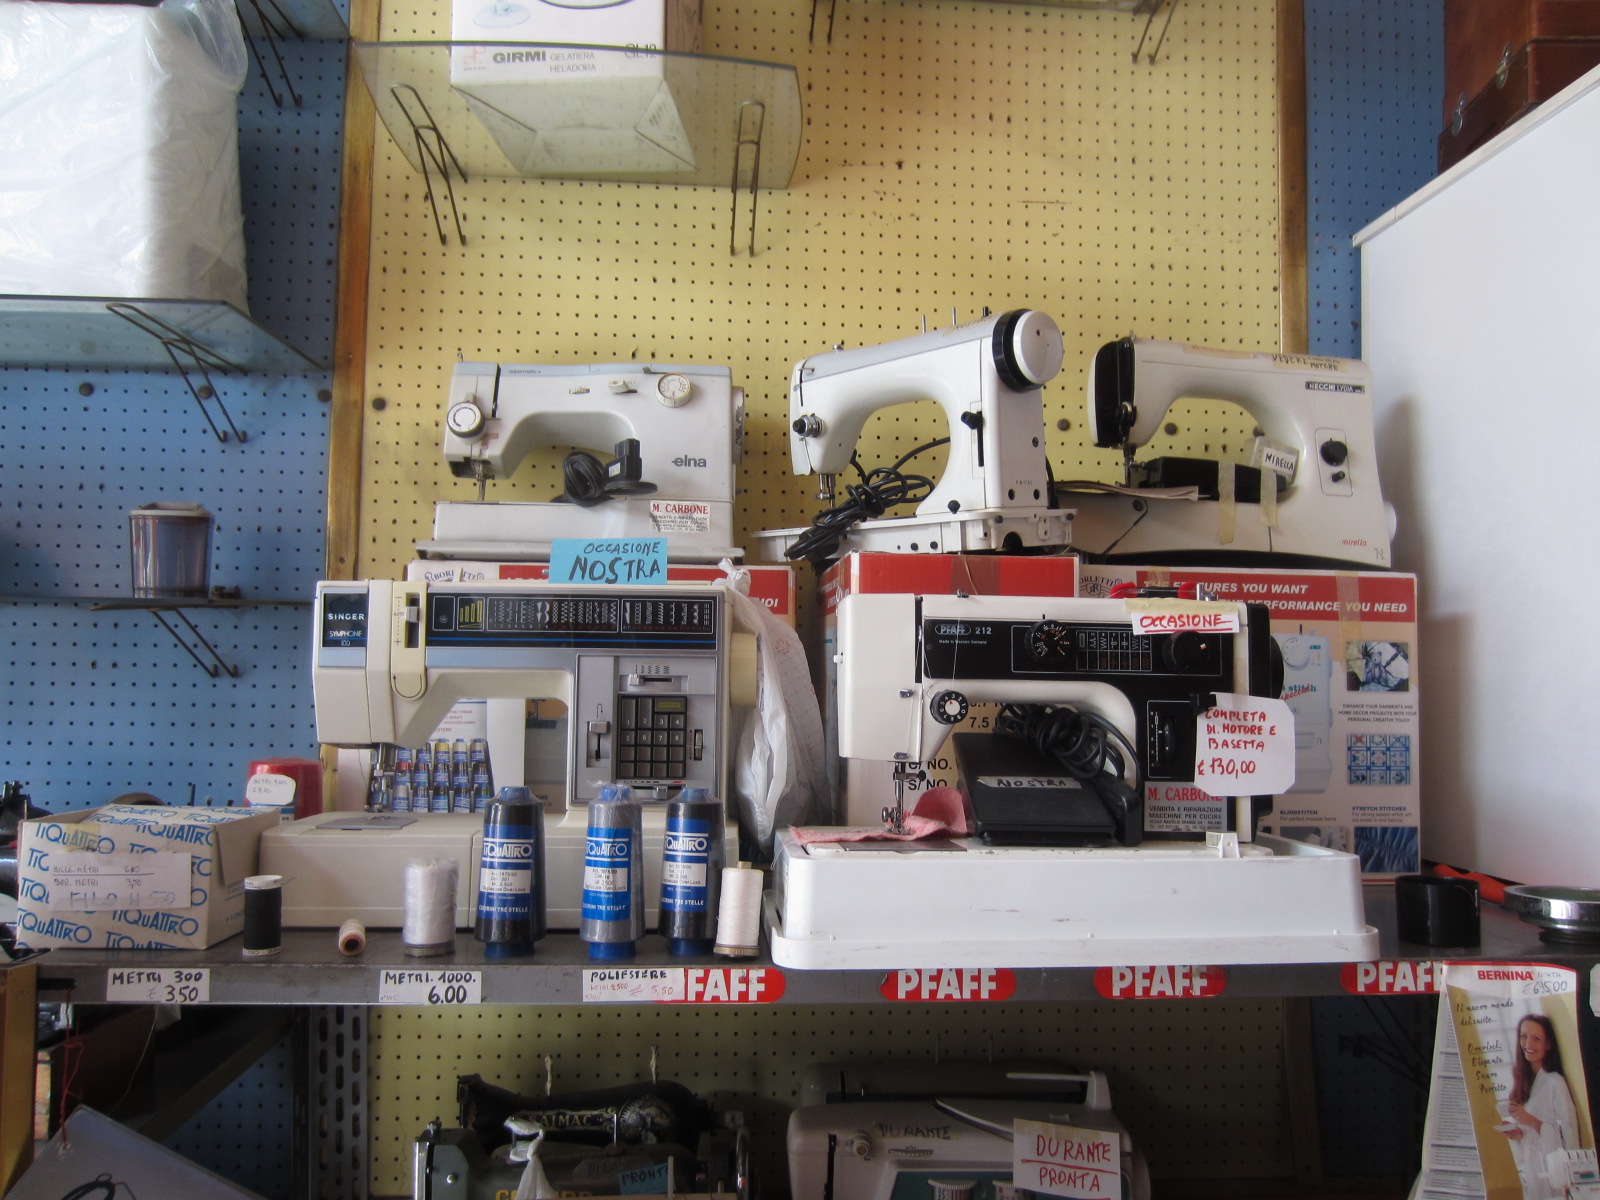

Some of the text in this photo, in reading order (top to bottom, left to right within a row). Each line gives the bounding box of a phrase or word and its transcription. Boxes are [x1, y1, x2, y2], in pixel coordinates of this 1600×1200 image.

[492, 51, 546, 64] GIRMI
[550, 52, 596, 62] GELATIERA
[550, 64, 596, 73] HELADORA
[672, 454, 707, 468] elna
[1265, 453, 1294, 471] MIRELLA
[652, 504, 708, 514] M. CARBONE
[584, 542, 660, 555] OCCASIONE
[434, 569, 476, 580] BORLTTI
[568, 555, 661, 584] NOSTRA
[1080, 576, 1116, 586] ORLETTI
[1173, 582, 1238, 592] FTURES
[1242, 584, 1268, 593] YOU
[1272, 584, 1308, 594] WANT
[1247, 600, 1407, 612] RFORMANCE YOU NEED
[1140, 614, 1233, 628] OCCASIONE
[329, 630, 362, 638] SYMPHONIE
[940, 625, 966, 634] PFAFF
[1205, 708, 1266, 722] COMPLETA
[970, 717, 989, 728] 7.5
[1222, 723, 1263, 735] MOTORE
[1269, 726, 1276, 736] E
[1208, 738, 1265, 752] BASETTA
[927, 759, 952, 770] NO.
[1210, 757, 1256, 779] 130,00
[996, 778, 1067, 787] NOSTRA
[1148, 787, 1160, 800] M.
[77, 866, 99, 874] METRI
[76, 878, 99, 887] METRI
[112, 971, 203, 985] METRI 300
[591, 970, 667, 982] POLIESTERE
[1111, 965, 1208, 996] PFAFF
[1477, 970, 1534, 981] BERNINA
[688, 968, 765, 1001] FAFF
[899, 968, 997, 999] PFAFF
[1466, 1003, 1488, 1011] nuovo
[1491, 998, 1514, 1009] mondo
[1460, 1017, 1472, 1026] del
[1472, 1057, 1503, 1067] Elegante
[1476, 1071, 1498, 1080] Sicuro
[1479, 1084, 1506, 1094] Perfetto
[879, 1124, 950, 1139] DURANTE
[1036, 1134, 1111, 1163] DURANTE
[621, 1166, 668, 1186] PRONT
[1039, 1167, 1100, 1191] PRONTA
